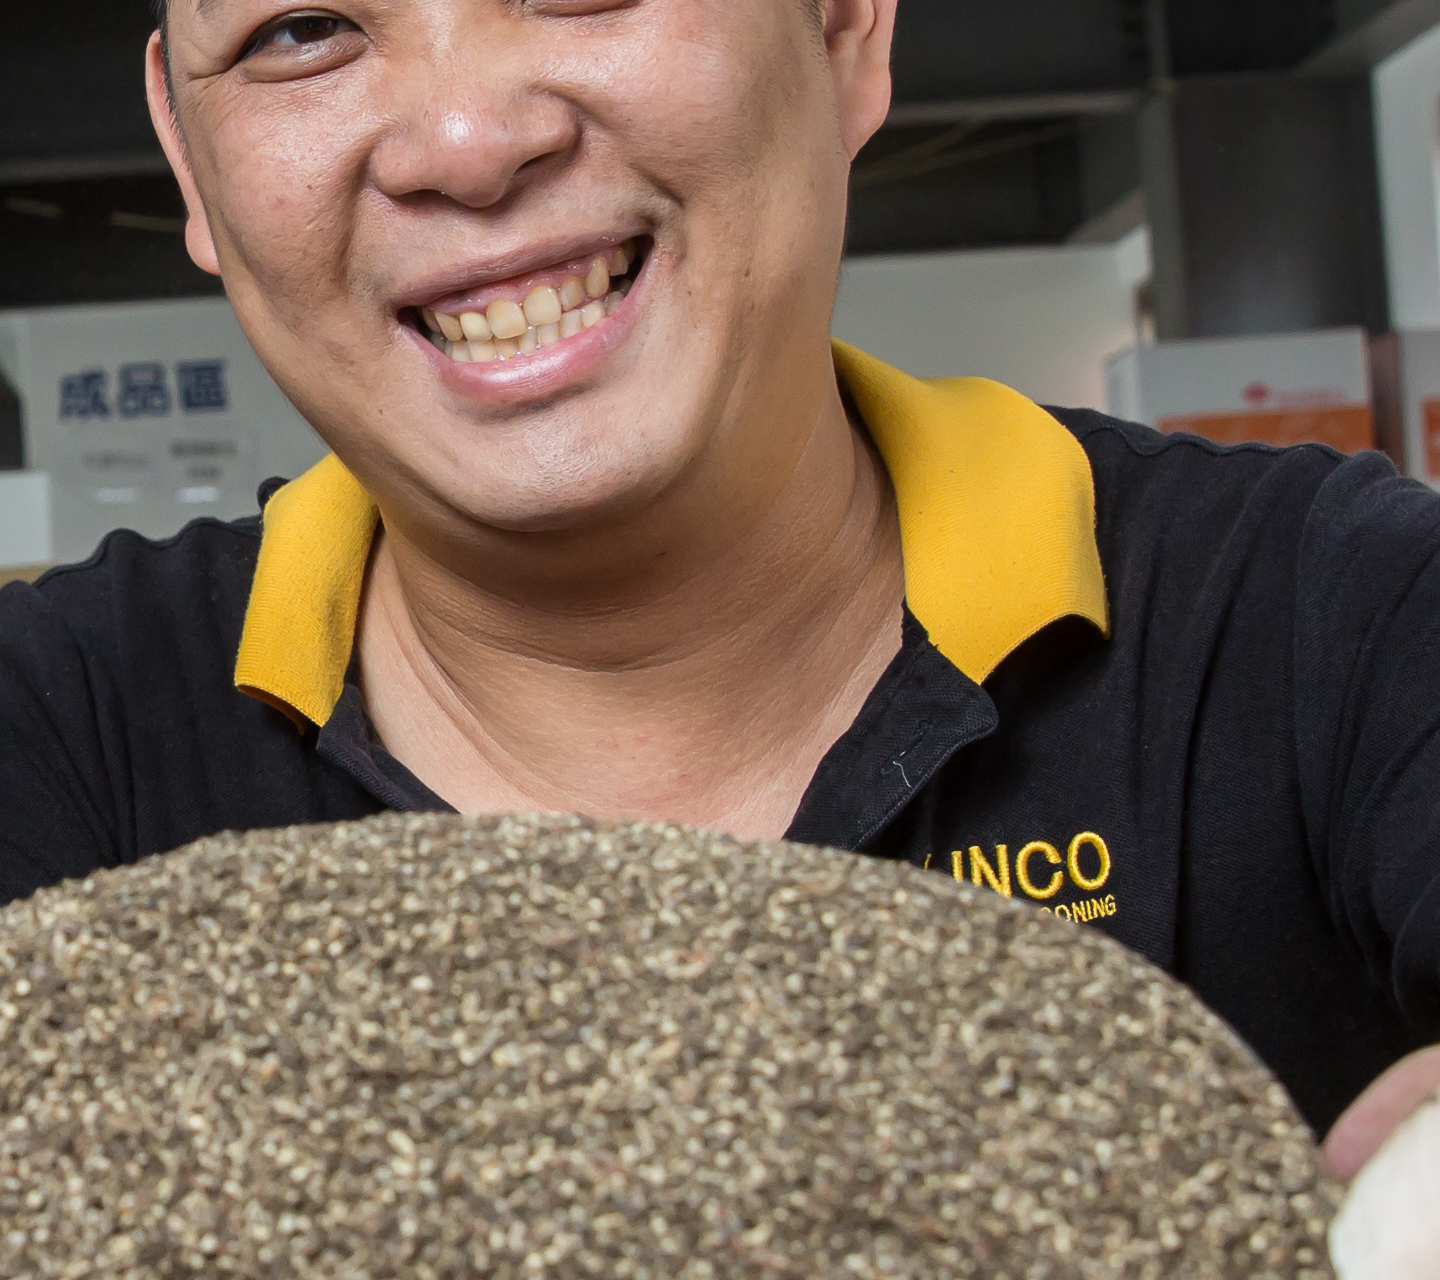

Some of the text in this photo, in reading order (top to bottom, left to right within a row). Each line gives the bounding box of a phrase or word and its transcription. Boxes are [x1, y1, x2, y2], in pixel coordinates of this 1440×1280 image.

[58, 359, 229, 421] 成品區
[924, 830, 1112, 899] INCO
